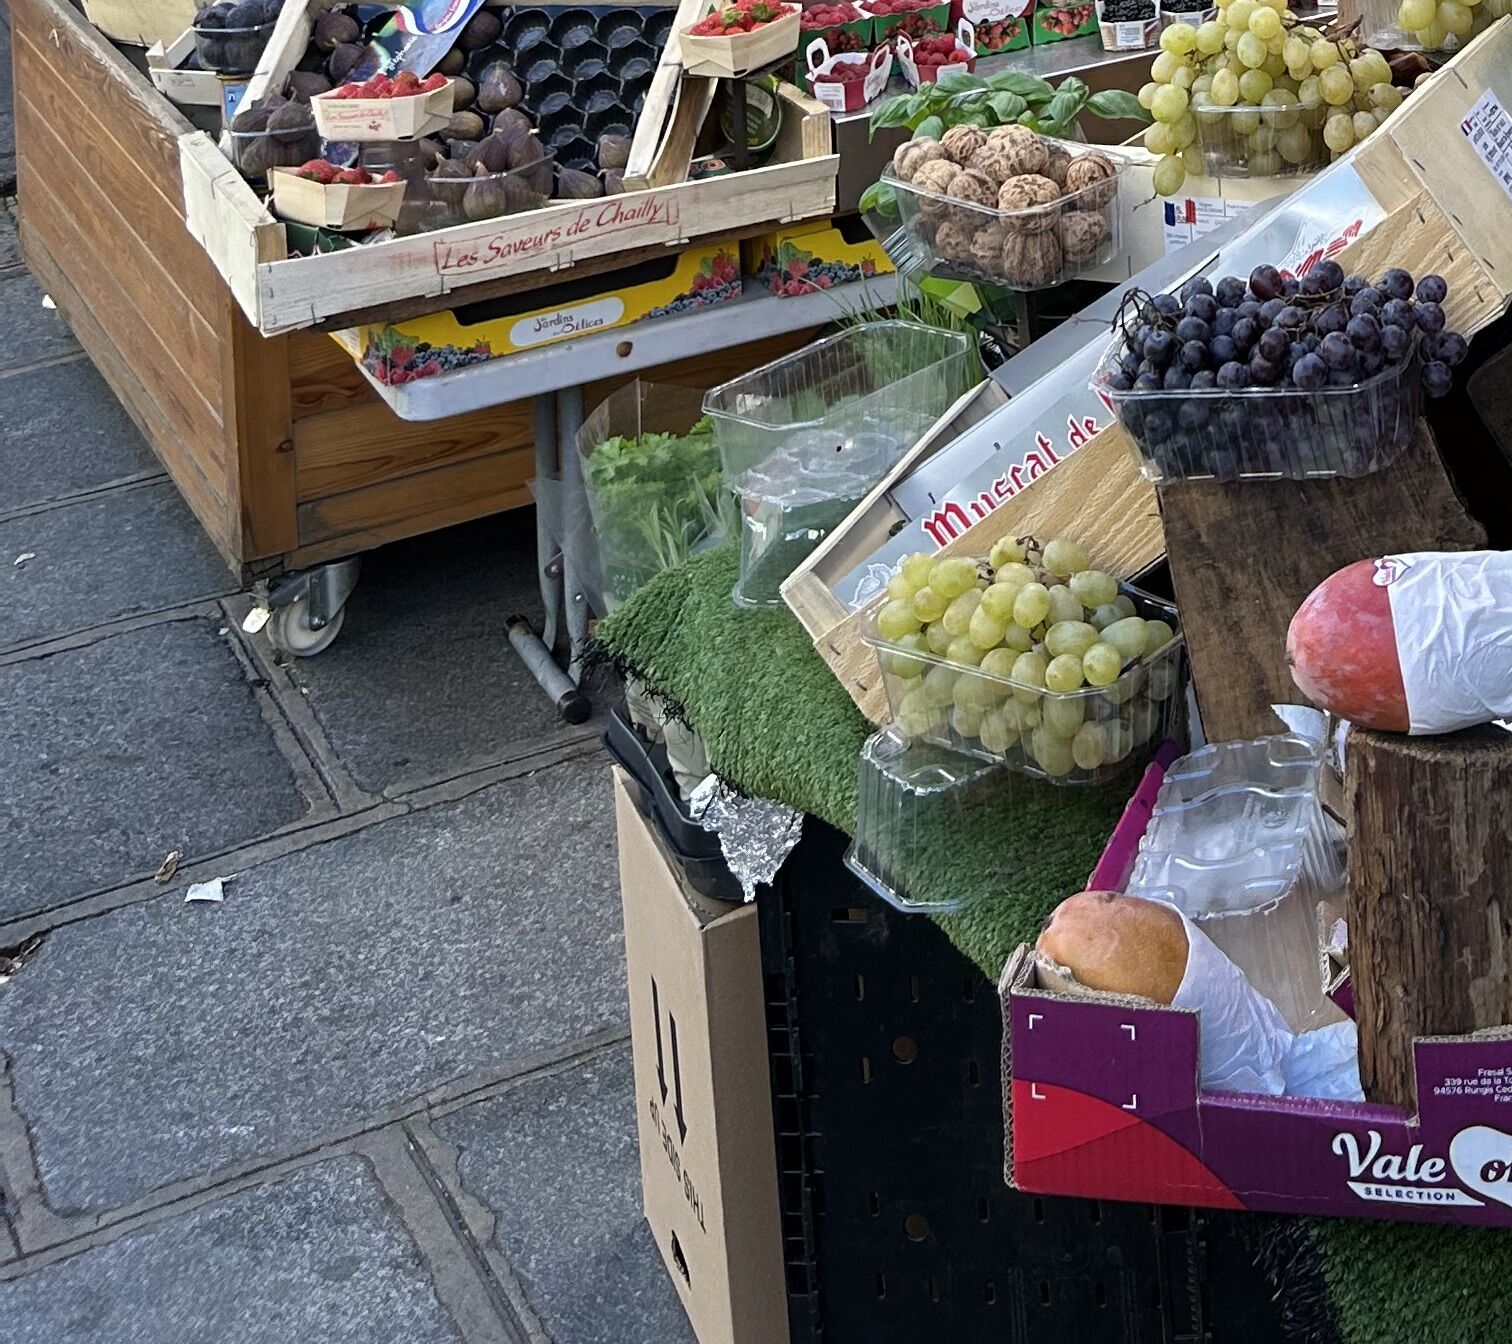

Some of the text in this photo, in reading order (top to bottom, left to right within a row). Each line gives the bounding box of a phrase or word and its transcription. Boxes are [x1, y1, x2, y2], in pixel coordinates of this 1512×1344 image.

[442, 199, 664, 272] Les Saveurs de Chailly
[534, 313, 574, 332] Jardins
[923, 415, 1102, 550] Muscat de
[1463, 1079, 1478, 1087] rue
[1480, 1077, 1491, 1087] de
[1492, 1077, 1501, 1086] la
[1464, 1086, 1489, 1097] Rungis
[1331, 1130, 1446, 1184] Vale
[1363, 1185, 1458, 1203] SELECTION
